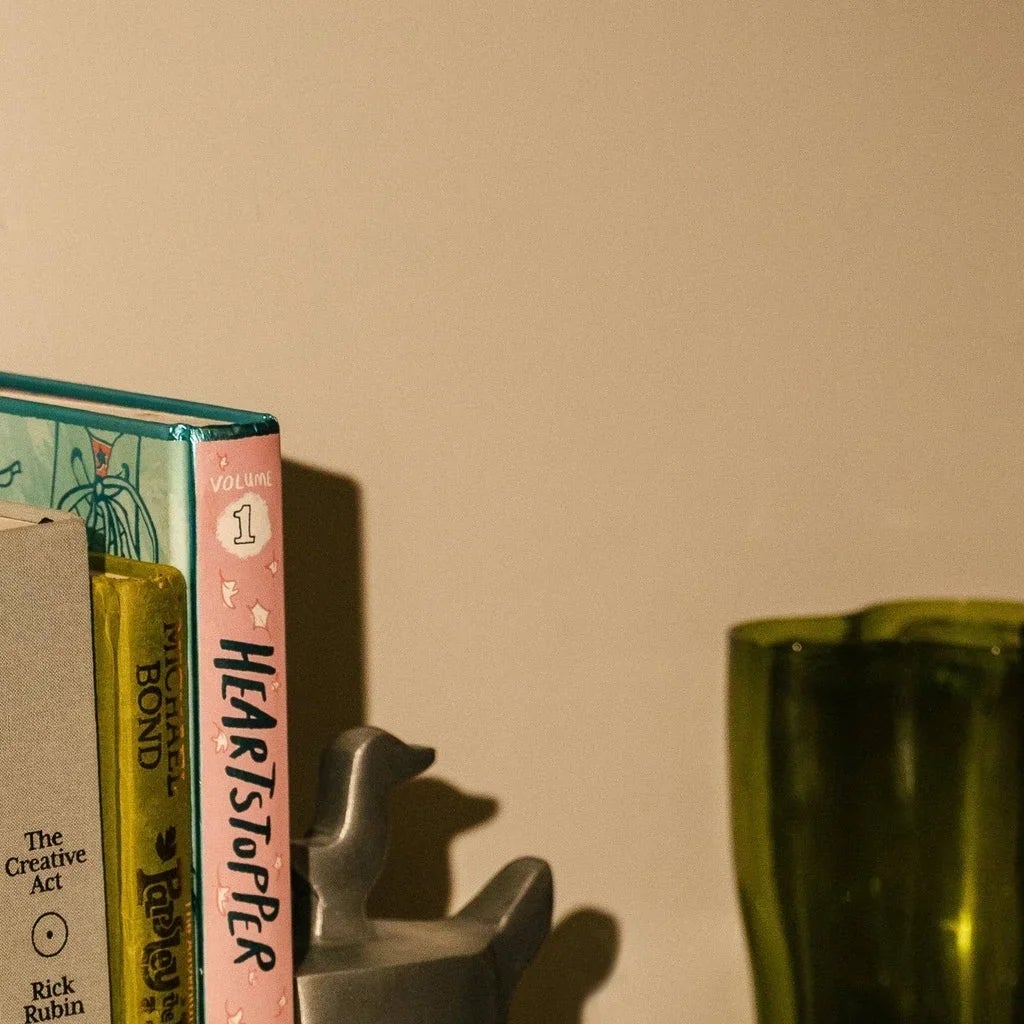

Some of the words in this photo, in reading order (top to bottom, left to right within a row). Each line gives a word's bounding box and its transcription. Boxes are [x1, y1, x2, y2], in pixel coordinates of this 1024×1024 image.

[209, 470, 273, 493] VOLUME
[232, 503, 256, 545] 1
[136, 660, 164, 770] BOND
[163, 617, 186, 798] MICHAEL
[212, 638, 280, 973] HEARTSTOPPER
[24, 828, 64, 852] The
[4, 848, 87, 877] Creative
[29, 872, 64, 895] Act
[30, 975, 76, 1002] Rick
[23, 998, 85, 1024] Rubin
